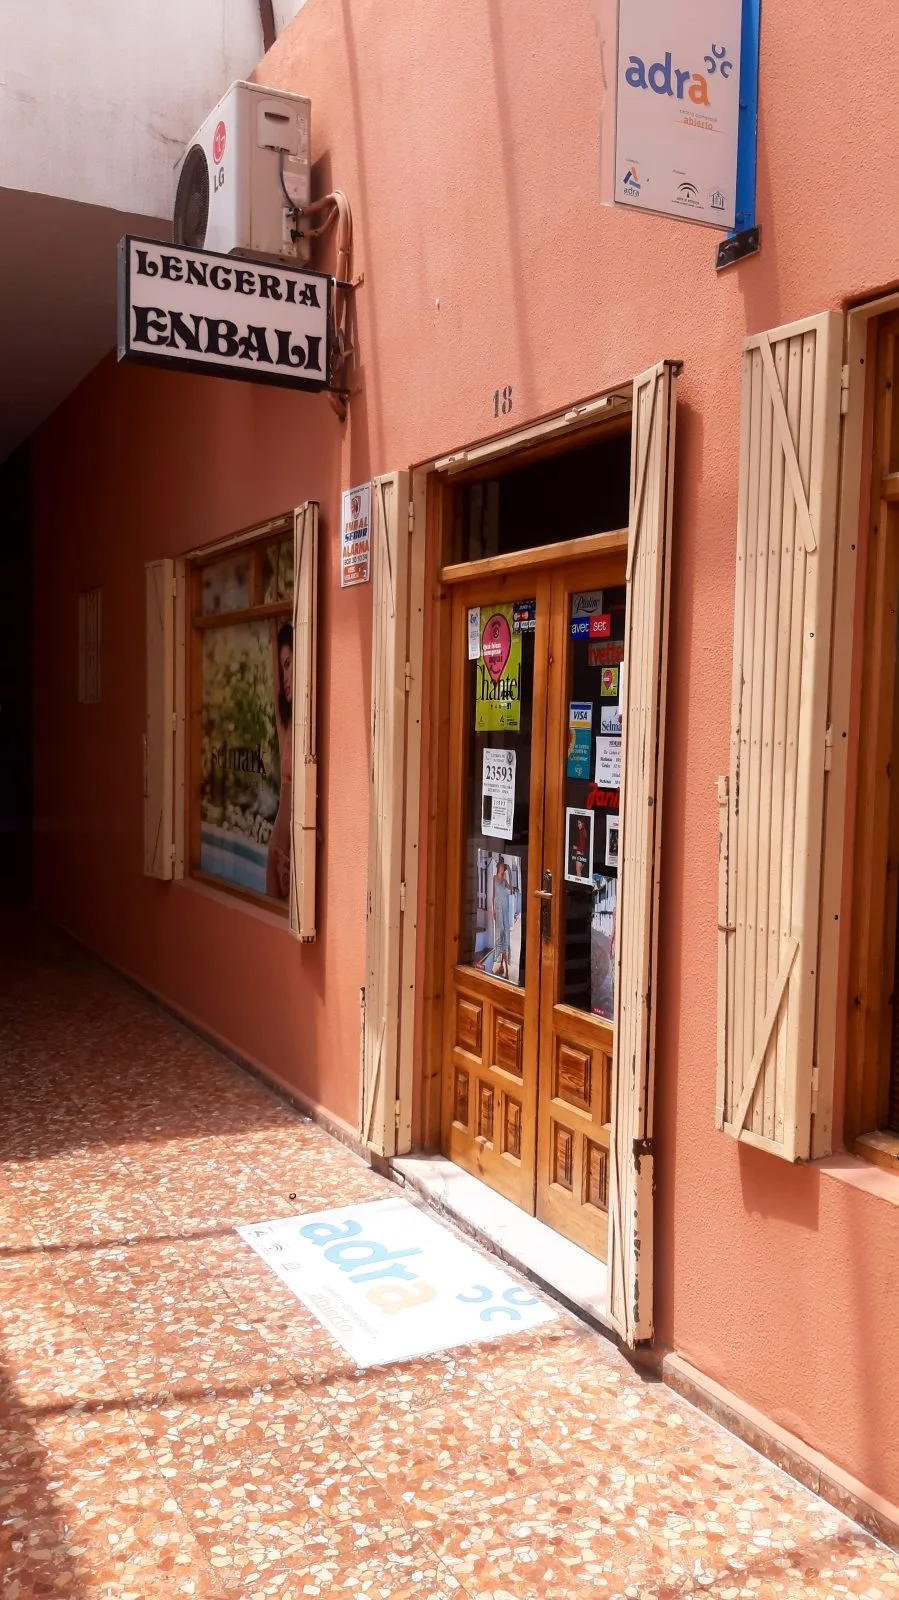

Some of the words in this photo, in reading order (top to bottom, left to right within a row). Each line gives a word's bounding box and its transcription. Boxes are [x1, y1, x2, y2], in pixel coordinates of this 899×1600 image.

[625, 51, 711, 107] adra
[213, 166, 225, 193] LG
[132, 305, 322, 373] ENBALI
[493, 385, 512, 418] 18
[343, 539, 369, 559] ALARMA
[571, 622, 589, 634] avec
[592, 620, 607, 632] sec
[573, 711, 588, 720] VISA
[486, 765, 513, 783] 23593
[300, 1219, 438, 1317] adra
